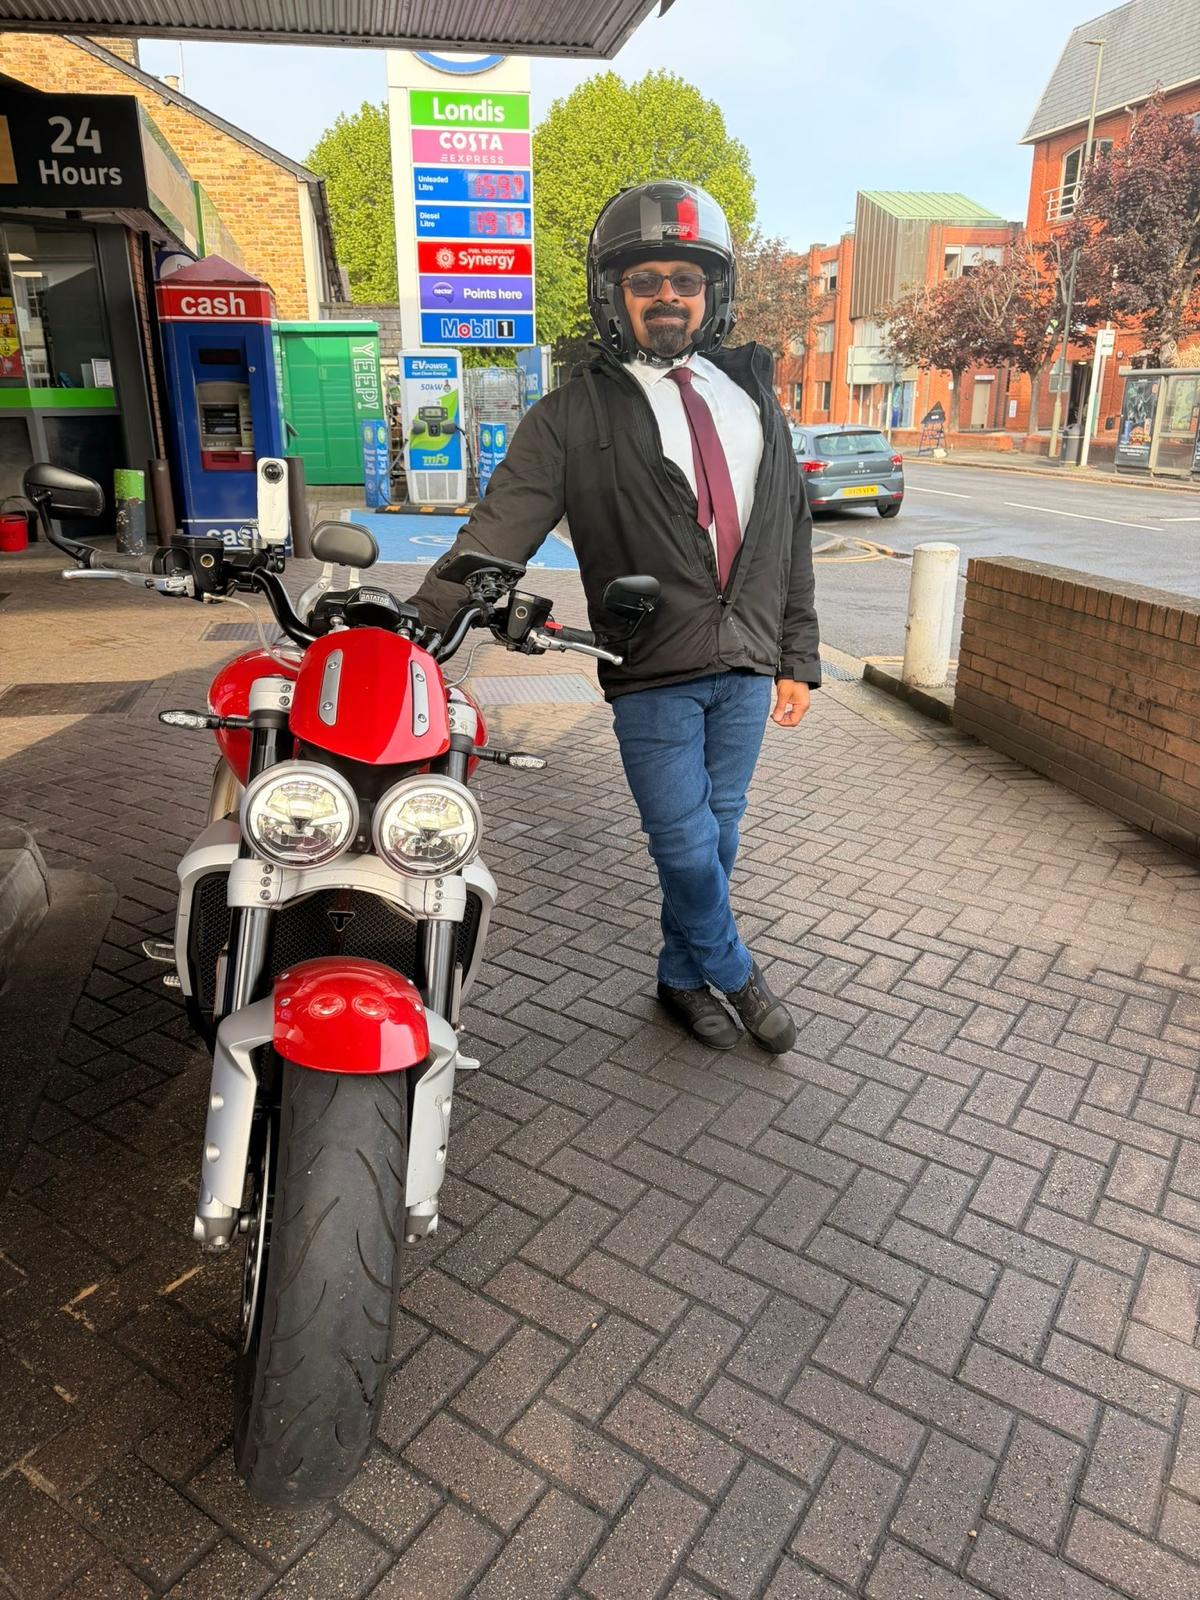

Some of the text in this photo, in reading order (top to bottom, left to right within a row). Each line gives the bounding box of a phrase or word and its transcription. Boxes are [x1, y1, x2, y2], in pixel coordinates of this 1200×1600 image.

[432, 96, 505, 123] Londis
[48, 115, 103, 154] 24
[440, 132, 503, 152] COSTA
[450, 154, 504, 164] EXPRESS
[38, 159, 123, 185] Hours
[418, 175, 449, 184] Unleaded
[419, 212, 441, 220] Diesel
[458, 251, 516, 271] Synergy
[463, 287, 523, 300] Points here
[180, 292, 247, 316] cash
[440, 318, 495, 339] Mobil
[352, 342, 380, 410] YEEP!
